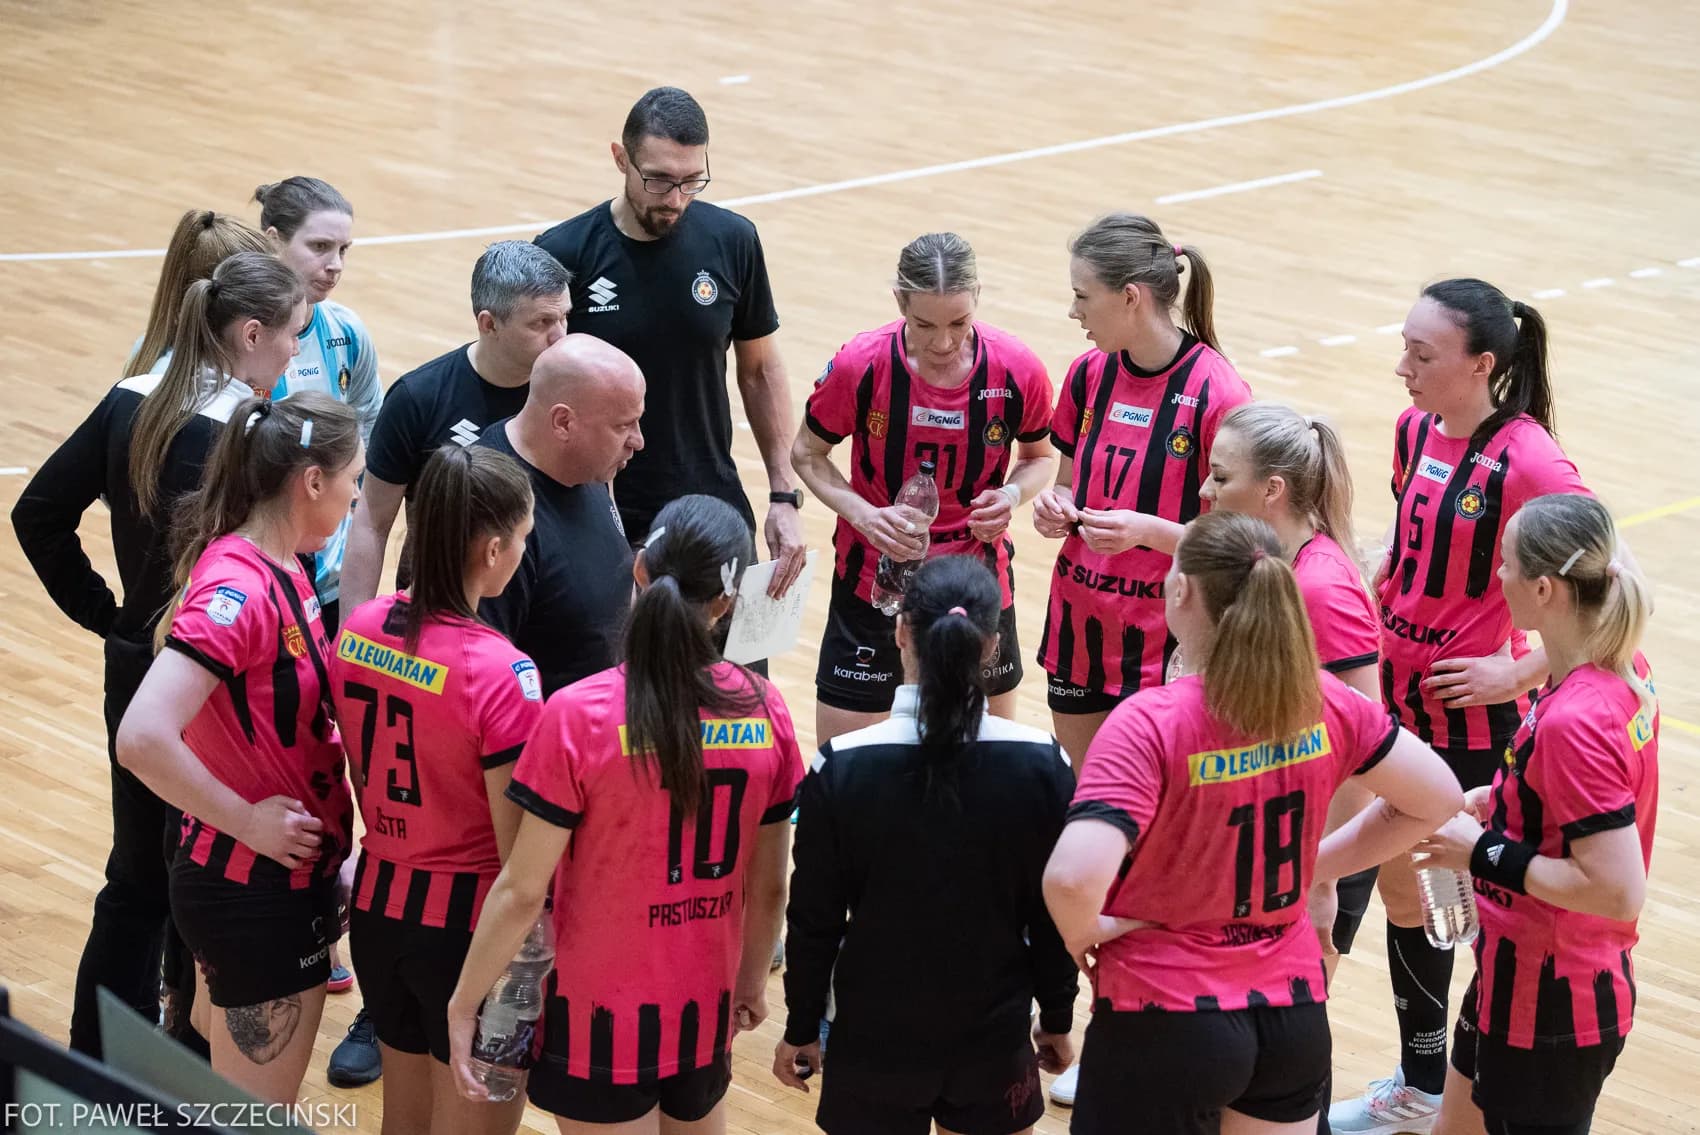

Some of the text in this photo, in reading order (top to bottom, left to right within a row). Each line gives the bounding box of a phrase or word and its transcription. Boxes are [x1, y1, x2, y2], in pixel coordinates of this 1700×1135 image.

[588, 304, 620, 313] SUZUKI
[927, 413, 961, 426] PGNiG
[1122, 410, 1150, 424] PGNiG
[1104, 443, 1137, 501] 17
[1425, 463, 1449, 480] PGNiG
[1407, 492, 1430, 551] 5
[355, 641, 438, 687] LEWIATAN
[834, 665, 888, 683] karabela
[983, 662, 1014, 679] OFIKA
[344, 679, 422, 808] 73
[701, 722, 766, 745] IATAN
[1229, 728, 1323, 777] LEWIATAN
[660, 768, 749, 886] 10
[1226, 789, 1306, 919] 18
[1472, 877, 1513, 909] UKI
[1415, 1046, 1443, 1055] KIELCE
